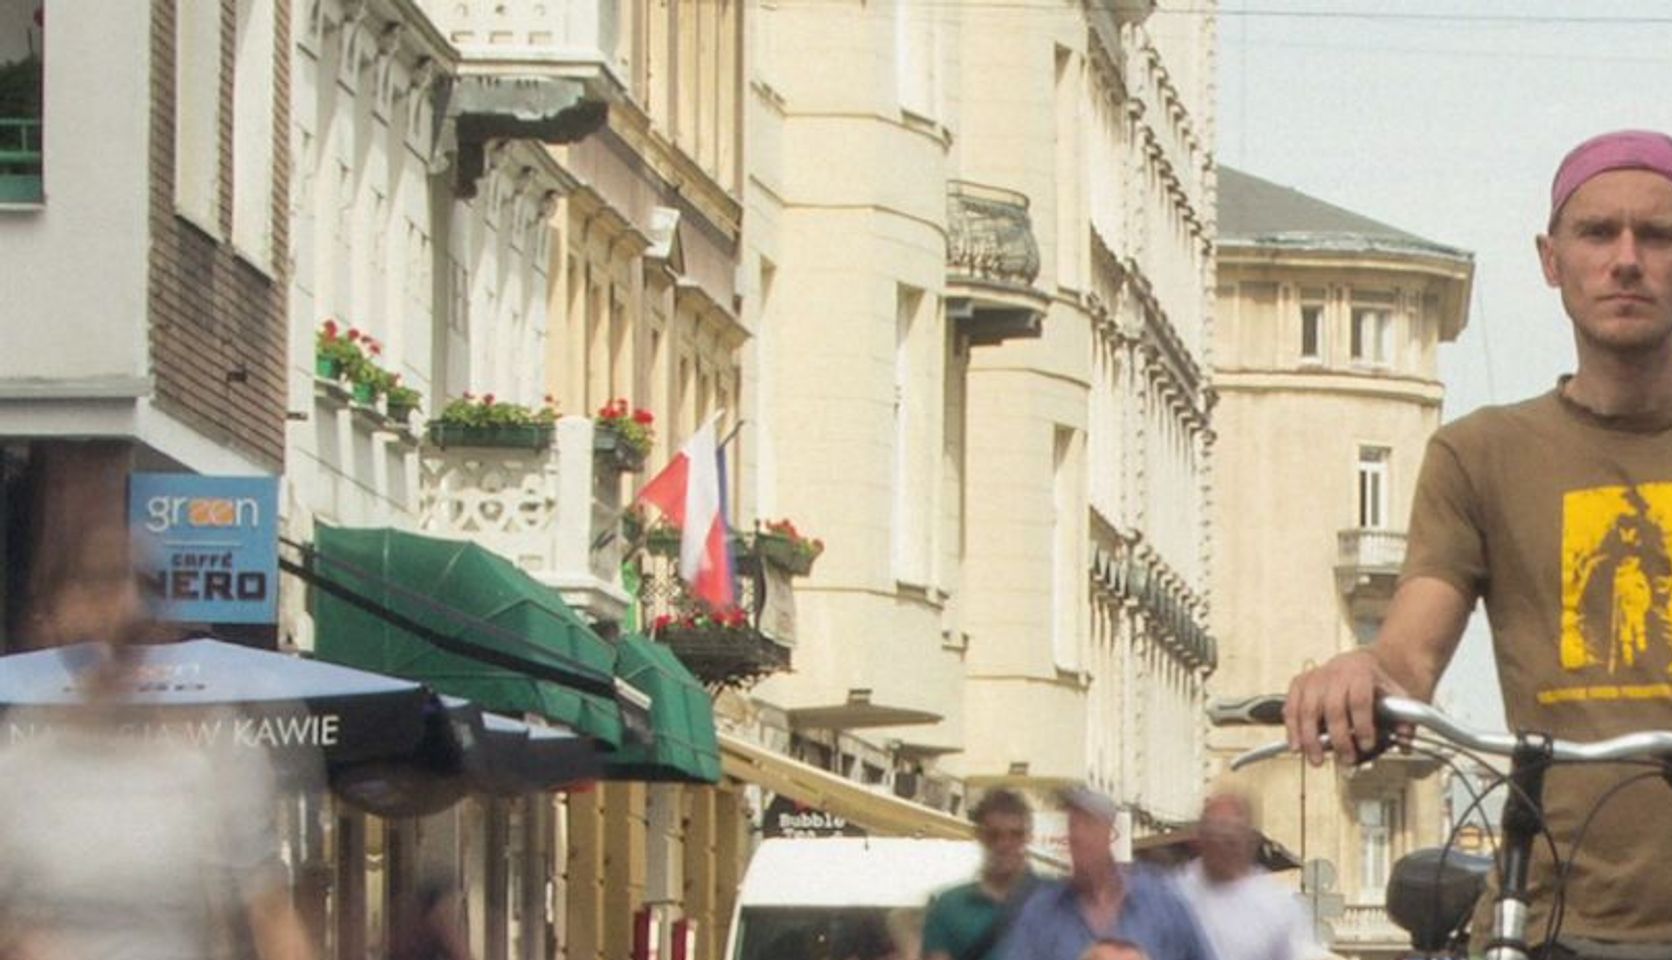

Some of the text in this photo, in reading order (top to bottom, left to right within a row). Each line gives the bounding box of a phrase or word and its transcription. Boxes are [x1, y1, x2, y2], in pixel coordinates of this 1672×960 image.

[146, 496, 259, 533] green
[139, 570, 266, 601] NERO
[232, 715, 340, 746] KAWIE
